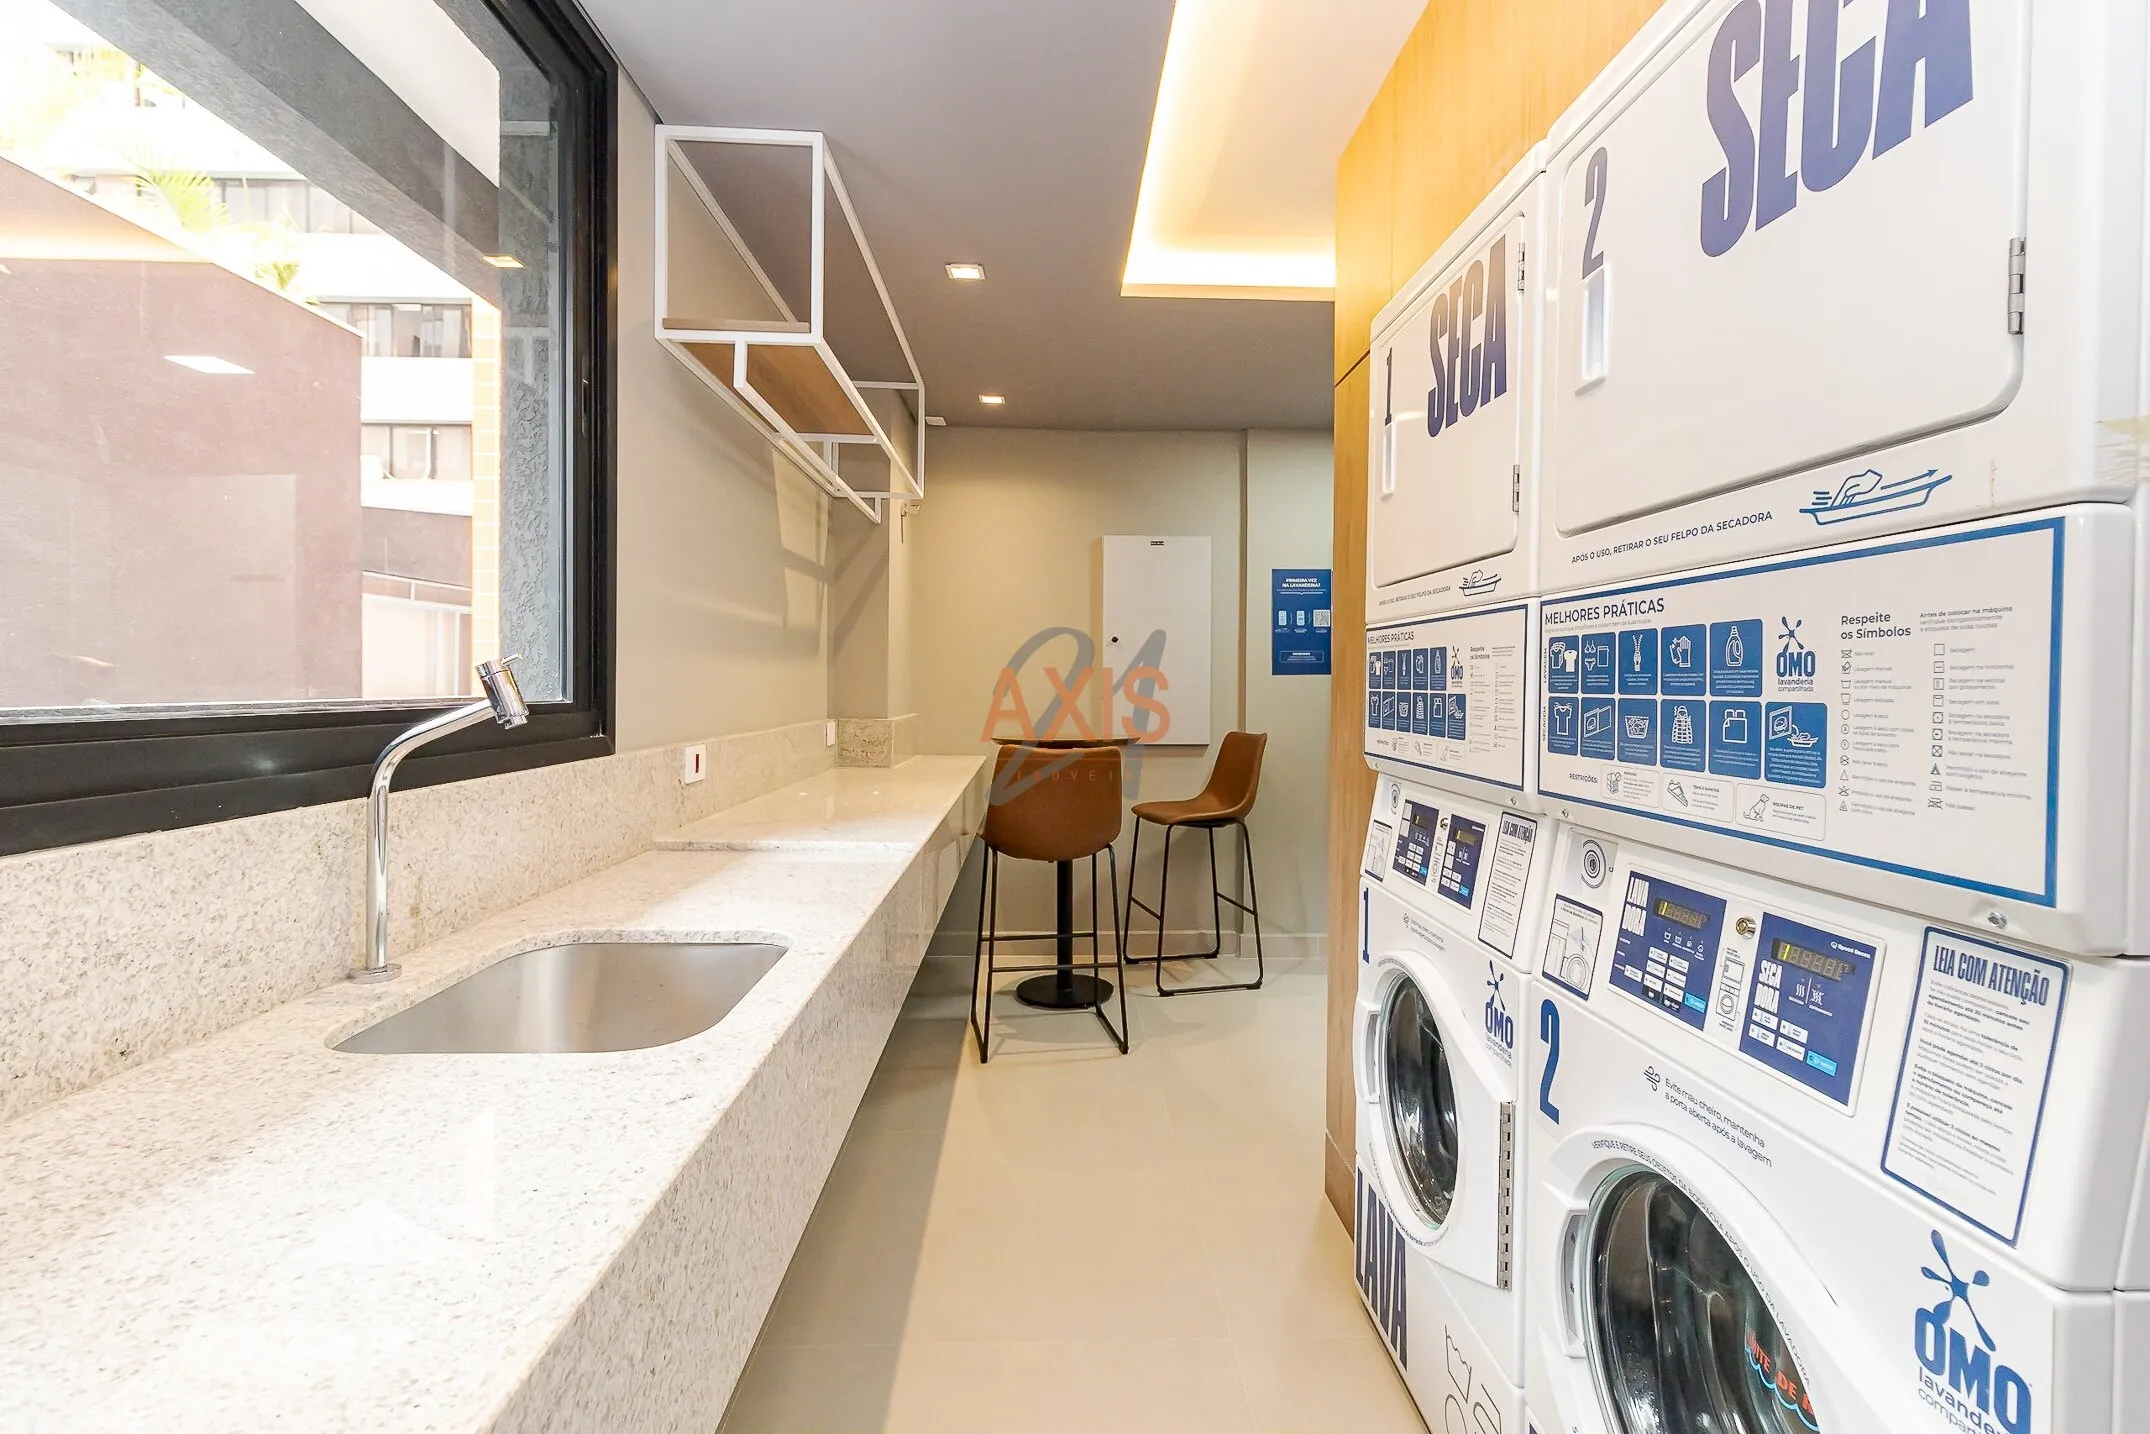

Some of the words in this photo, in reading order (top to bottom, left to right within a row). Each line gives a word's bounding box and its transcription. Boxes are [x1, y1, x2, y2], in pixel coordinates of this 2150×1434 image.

[1700, 0, 1974, 257] SECA
[1581, 145, 1608, 280] 2
[1427, 234, 1507, 439] SECA
[1384, 346, 1393, 426] 1
[1571, 552, 1589, 564] APÓS
[1596, 547, 1612, 558] USO,
[1613, 540, 1644, 555] RETIRAR
[1645, 538, 1652, 547] O
[1653, 534, 1669, 546] SEU
[1671, 527, 1699, 542] FELPO
[1700, 524, 1715, 535] DA
[1716, 510, 1773, 531] SECADORA
[1545, 606, 1600, 626] MELHORES
[1603, 598, 1665, 619] PRÁTICAS
[1840, 629, 1853, 640] os
[1856, 626, 1911, 639] Símbolos
[1841, 612, 1891, 626] Respeite
[1776, 651, 1816, 678] OMO
[1777, 678, 1814, 686] lavanderia
[1362, 886, 1370, 964] 1
[1933, 945, 1956, 978] LEIA
[1957, 952, 1989, 987] COM
[1988, 962, 2050, 1008] ATENÇÃO
[1485, 1001, 1514, 1049] OMO
[1540, 998, 1560, 1126] 2
[1665, 1078, 1681, 1095] Evite
[1681, 1090, 1698, 1105] mau
[1699, 1099, 1723, 1122] cheiro,
[1723, 1116, 1765, 1148] mantenha
[1665, 1092, 1670, 1100] a
[1670, 1095, 1688, 1112] porta
[1688, 1107, 1711, 1127] aberta
[1711, 1122, 1730, 1140] após
[1730, 1135, 1736, 1143] a
[1737, 1136, 1772, 1168] lavagem
[1355, 1164, 1408, 1372] LAVA
[1776, 1370, 1797, 1400] DE
[1914, 1302, 2031, 1434] OMO
